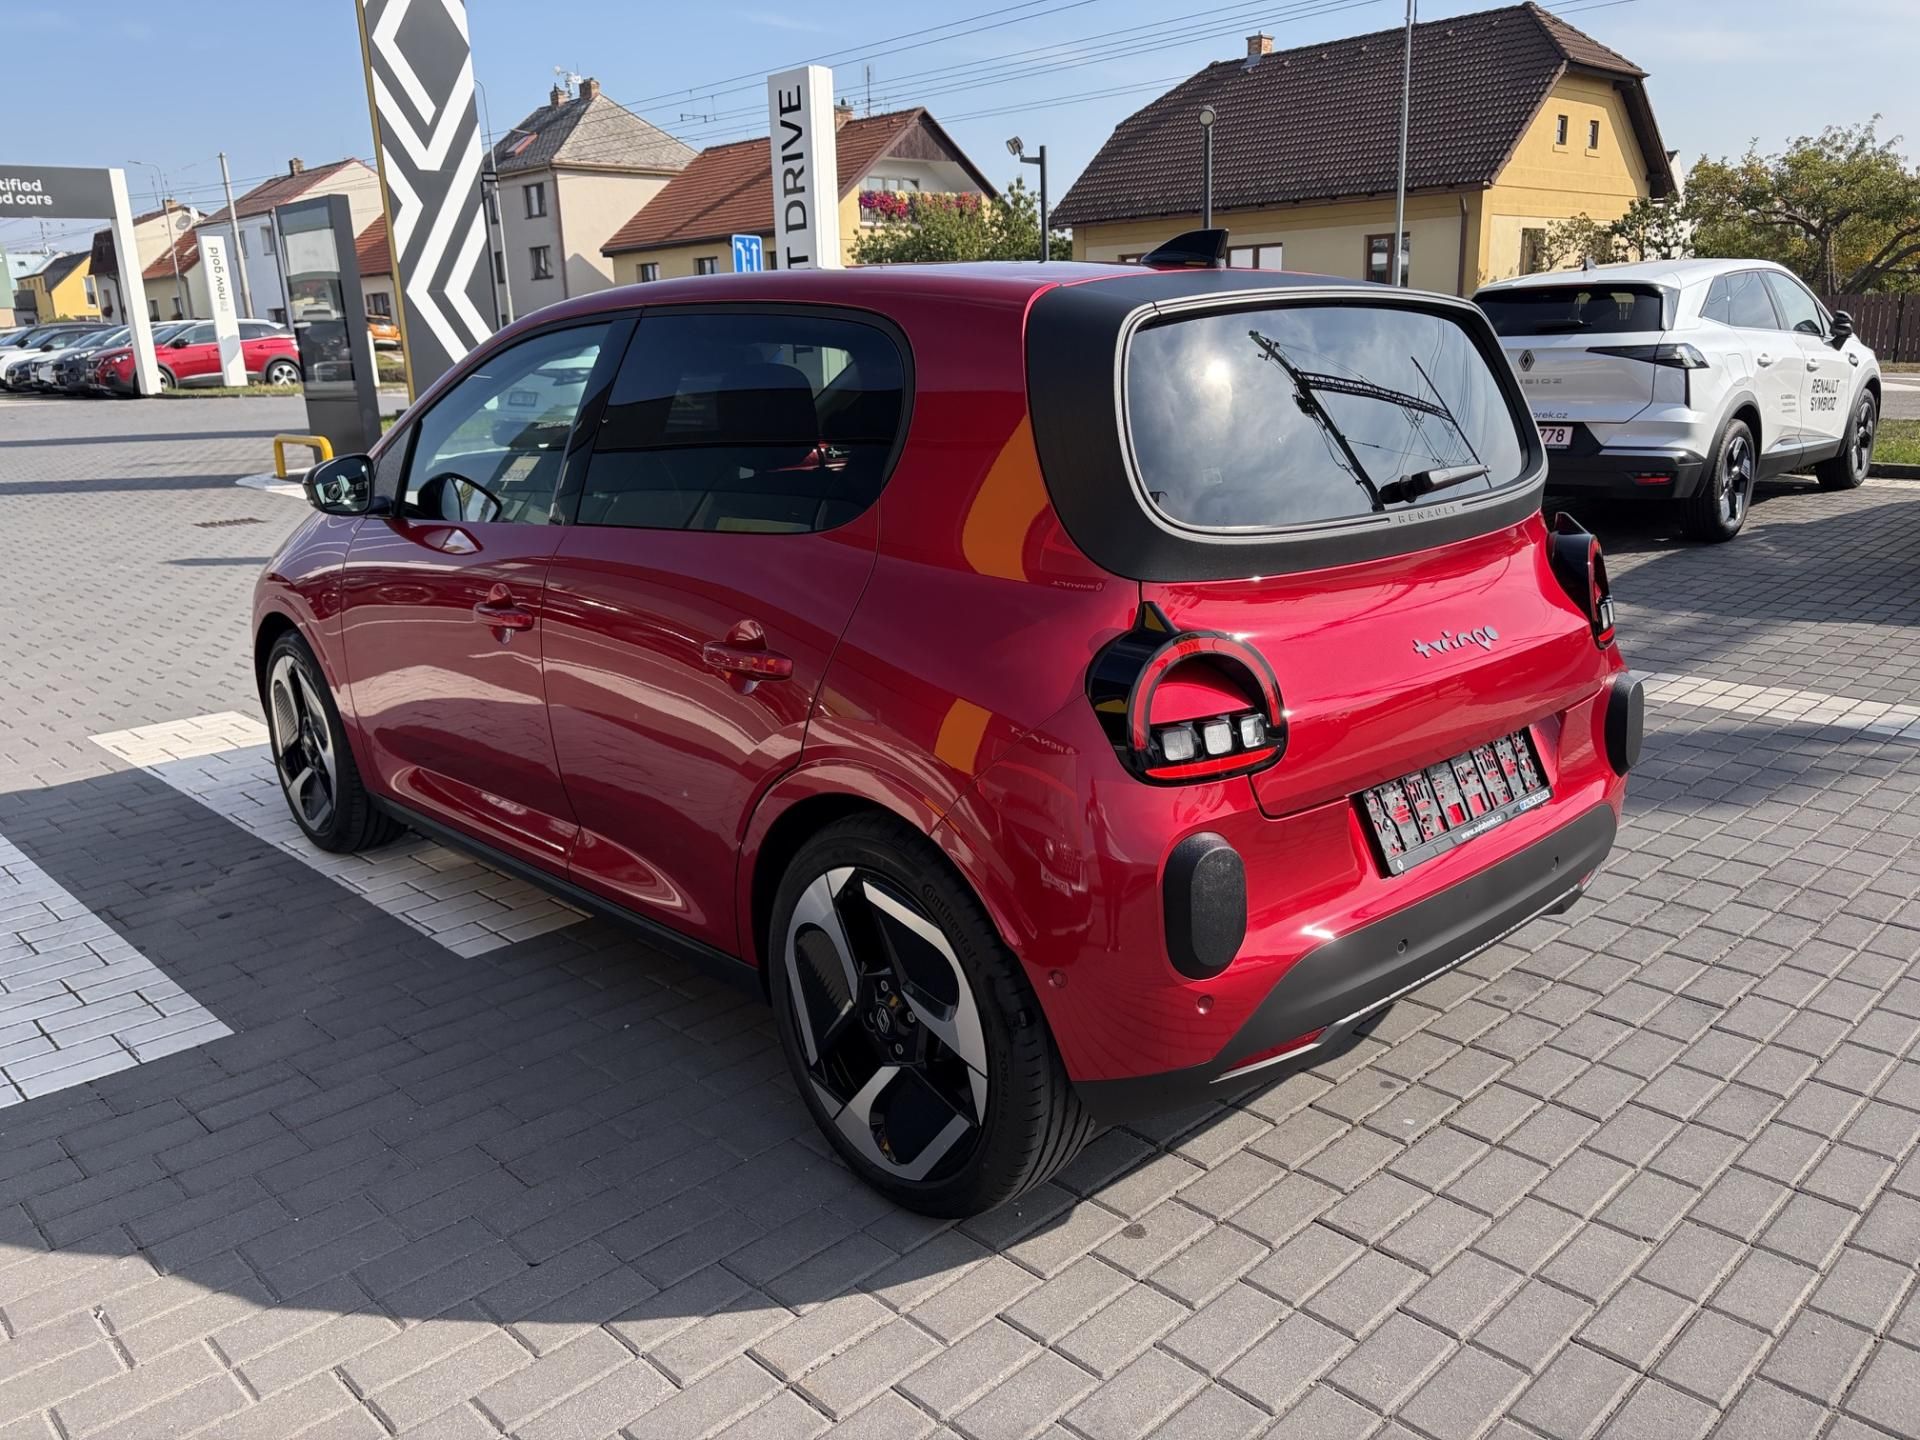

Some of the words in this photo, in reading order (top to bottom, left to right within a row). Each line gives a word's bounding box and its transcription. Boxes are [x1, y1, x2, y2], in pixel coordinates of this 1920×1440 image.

[778, 84, 807, 234] DRIVE
[15, 194, 53, 206] cars
[207, 246, 225, 274] gold
[1811, 378, 1840, 393] RENAULT
[1810, 396, 1837, 411] SYMBIOZ
[1397, 505, 1458, 524] RENAULT
[1412, 625, 1500, 659] twingo
[921, 883, 977, 960] Continental
